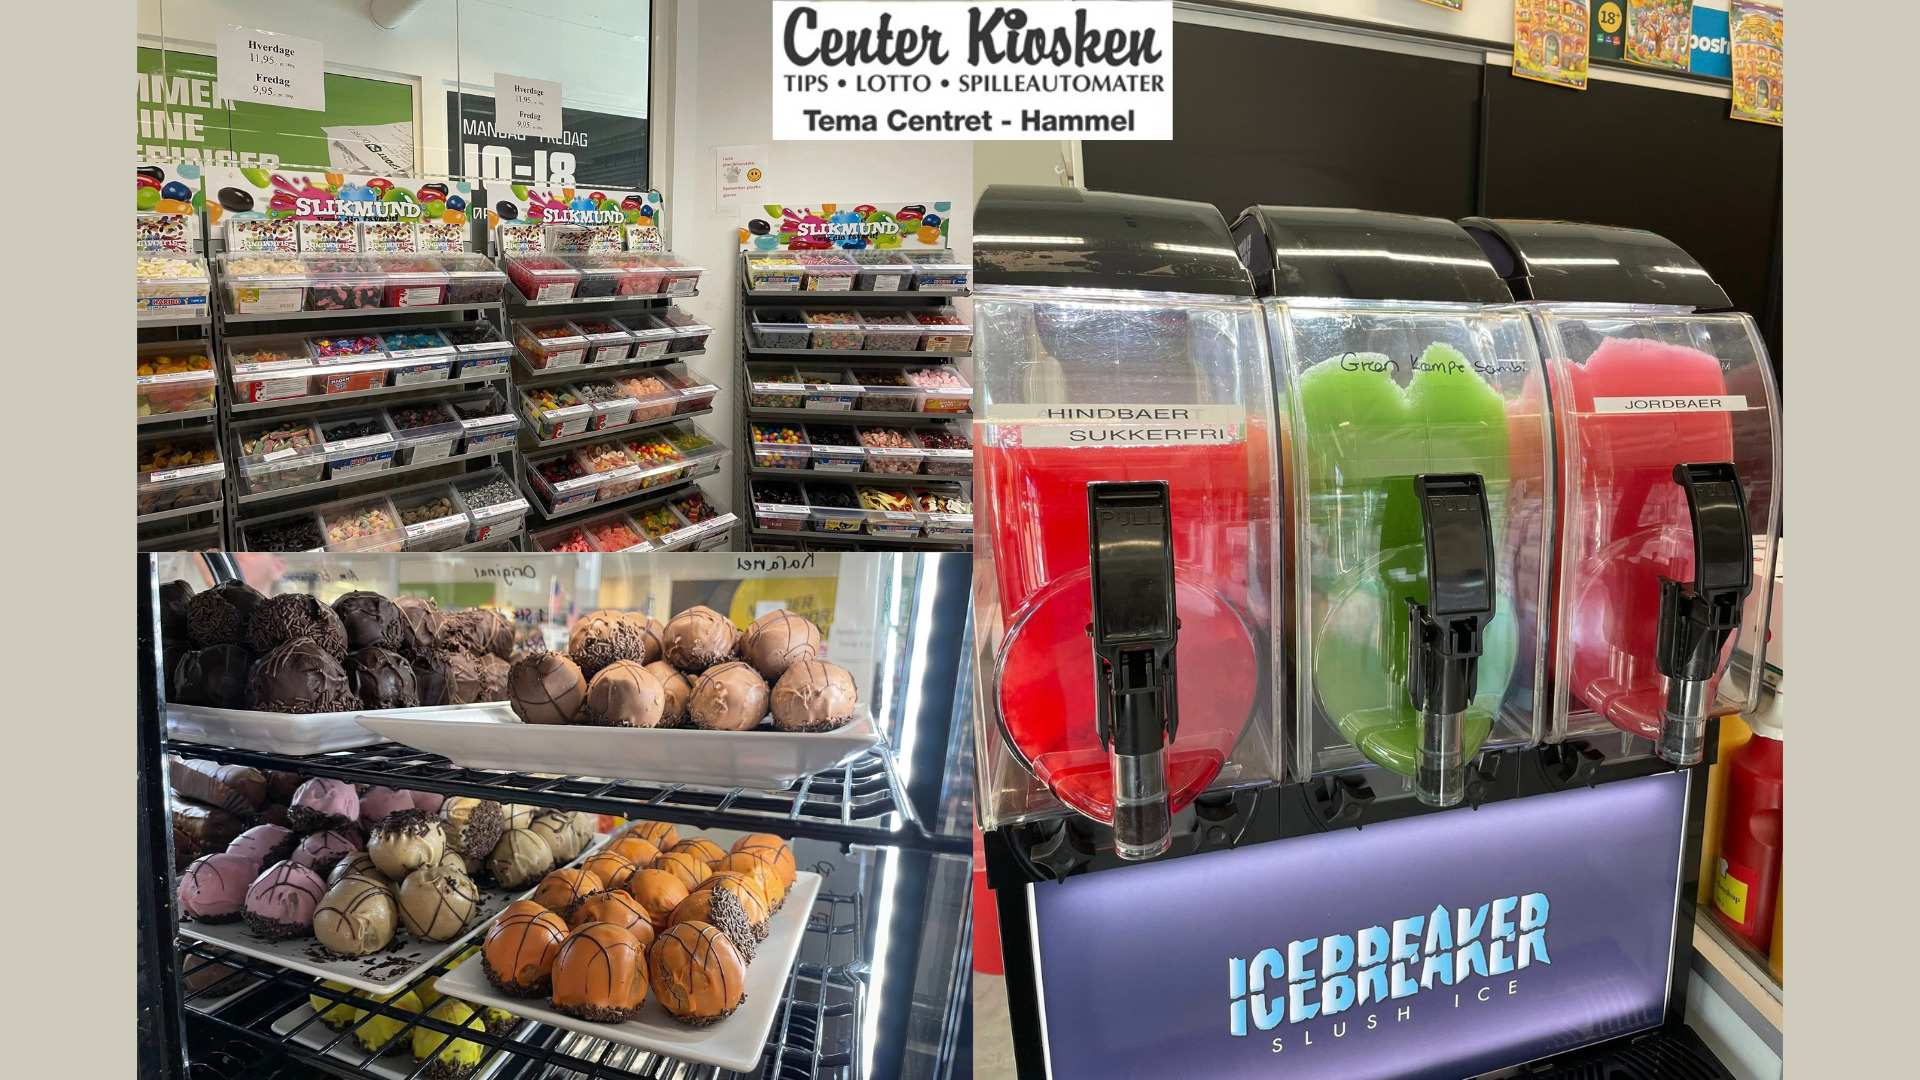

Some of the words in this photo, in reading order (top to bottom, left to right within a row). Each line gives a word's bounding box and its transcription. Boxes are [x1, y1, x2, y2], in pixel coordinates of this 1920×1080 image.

[248, 40, 295, 57] Hverdage
[255, 73, 290, 88] Fredag
[514, 85, 544, 97] Hverdage
[519, 111, 541, 121] Fredag
[295, 198, 421, 218] SLIKMUND
[543, 208, 625, 224] SLIKMUND
[797, 221, 899, 236] SLIKMUND
[1624, 399, 1722, 410] JORDBAER
[1047, 407, 1190, 420] HINDBAER
[1069, 429, 1225, 442] SUKKERFRI
[1100, 510, 1163, 527] PULL
[1228, 892, 1551, 1037] ICEBREAKER
[1271, 1006, 1411, 1053] SLUSH
[1455, 979, 1518, 1008] ICE
